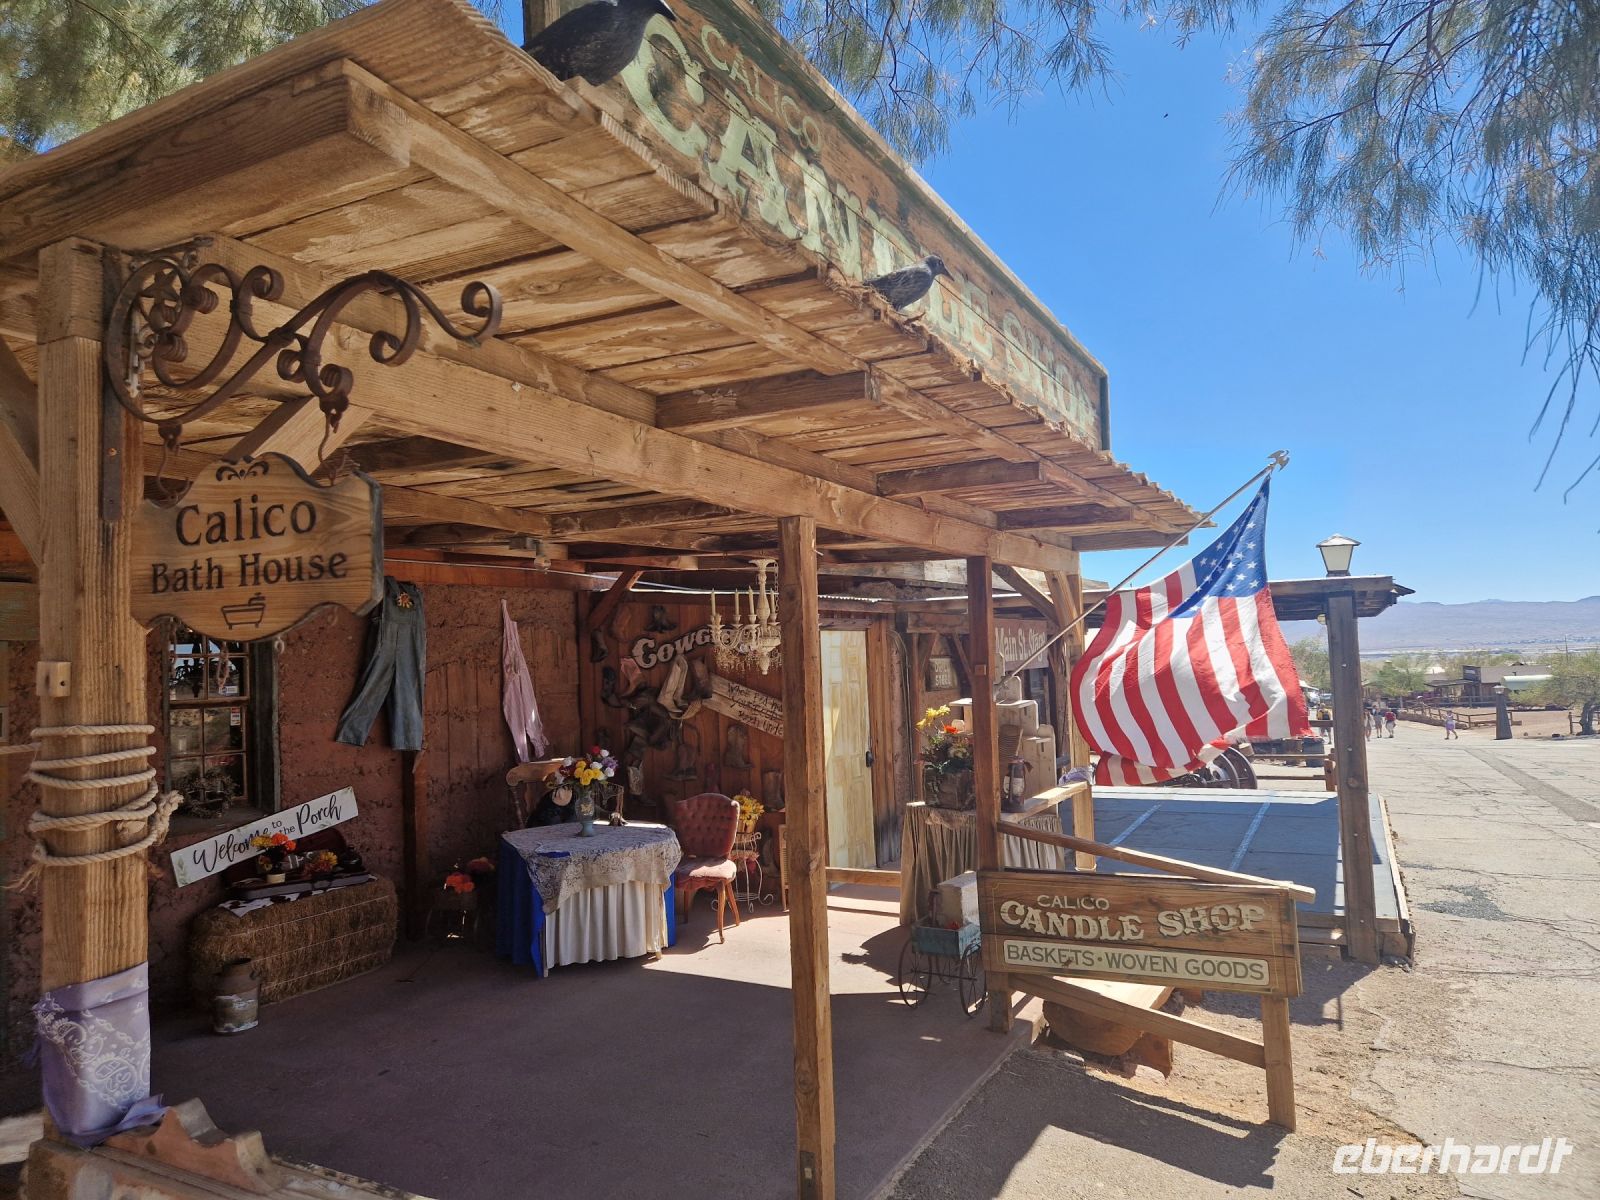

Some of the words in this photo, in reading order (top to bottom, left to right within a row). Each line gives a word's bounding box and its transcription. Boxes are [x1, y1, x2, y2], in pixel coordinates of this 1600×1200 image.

[701, 24, 821, 151] CALICO
[1001, 308, 1097, 442] SHOP
[175, 494, 317, 546] Calico
[151, 557, 225, 595] Bath
[238, 551, 348, 588] House
[995, 627, 1018, 661] Main
[193, 824, 270, 873] Welcome
[271, 819, 282, 829] to
[296, 794, 342, 835] Porch
[1000, 900, 1144, 942] CANDLE
[1157, 904, 1265, 938] SHOP
[1036, 893, 1110, 912] CALICO
[1007, 944, 1094, 967] BASKETS
[1105, 951, 1178, 975] WOVEN
[1184, 958, 1264, 981] GOODS
